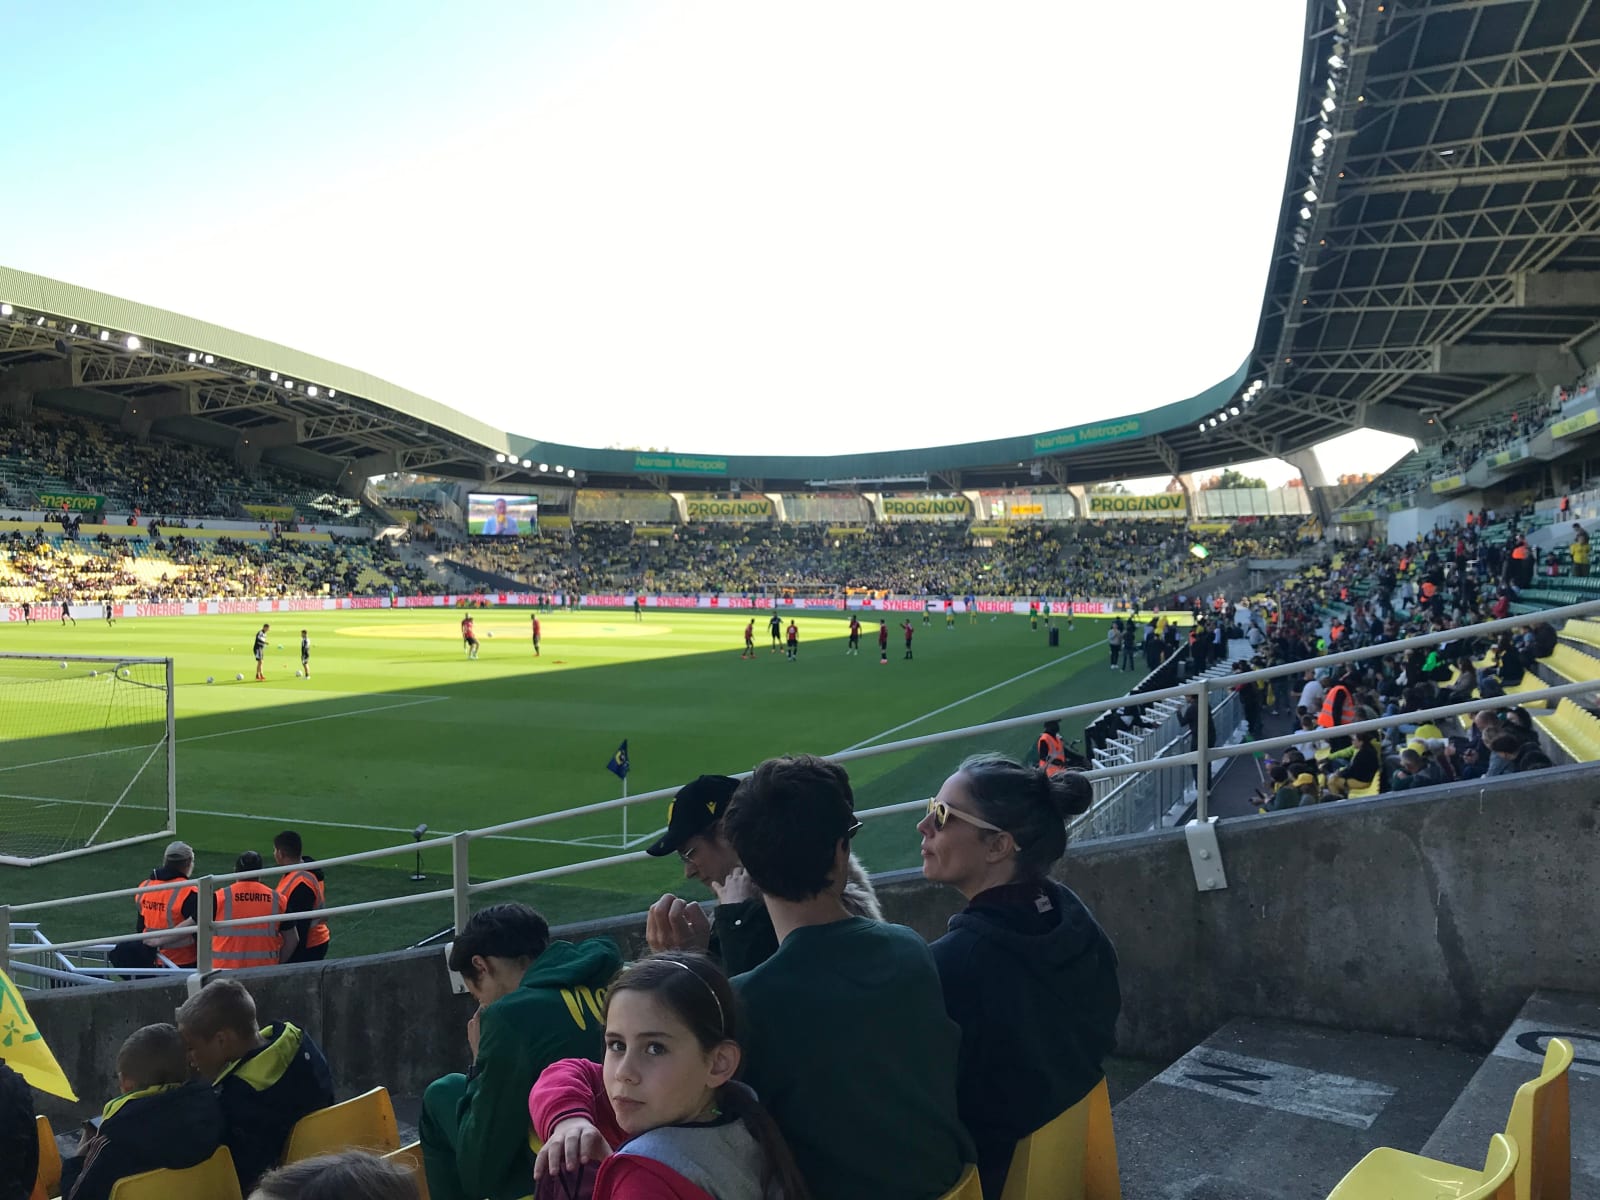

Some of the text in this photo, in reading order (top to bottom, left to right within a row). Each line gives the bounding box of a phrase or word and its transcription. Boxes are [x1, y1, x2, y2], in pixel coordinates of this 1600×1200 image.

[688, 502, 769, 515] PROG/NOV
[884, 500, 966, 514] PROG/NOV
[1091, 495, 1182, 512] PROG/NOV
[1053, 601, 1104, 613] SYERGIE
[234, 892, 272, 903] SECURITE
